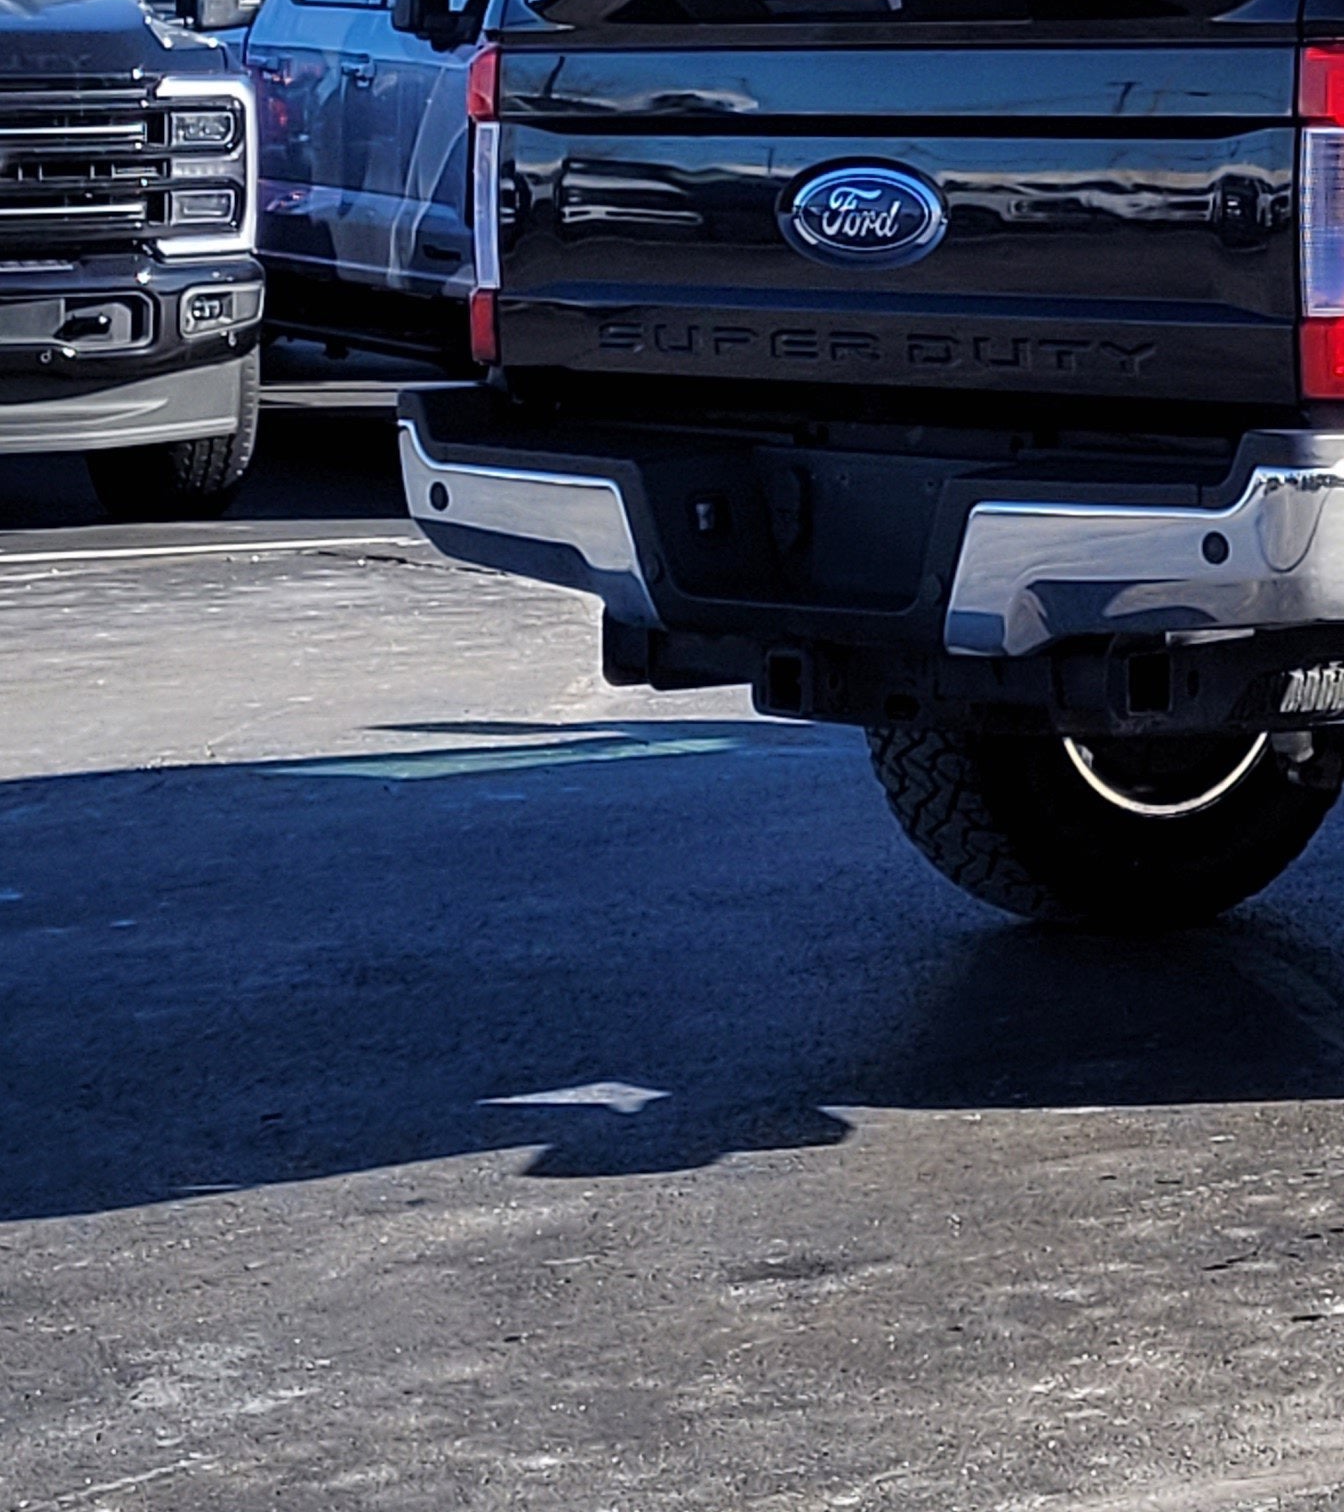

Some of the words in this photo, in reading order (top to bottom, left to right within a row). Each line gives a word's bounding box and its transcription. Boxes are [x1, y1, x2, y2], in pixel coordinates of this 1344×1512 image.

[821, 186, 902, 238] Ford
[599, 322, 881, 361] SUPER
[906, 333, 1157, 377] DUTY
